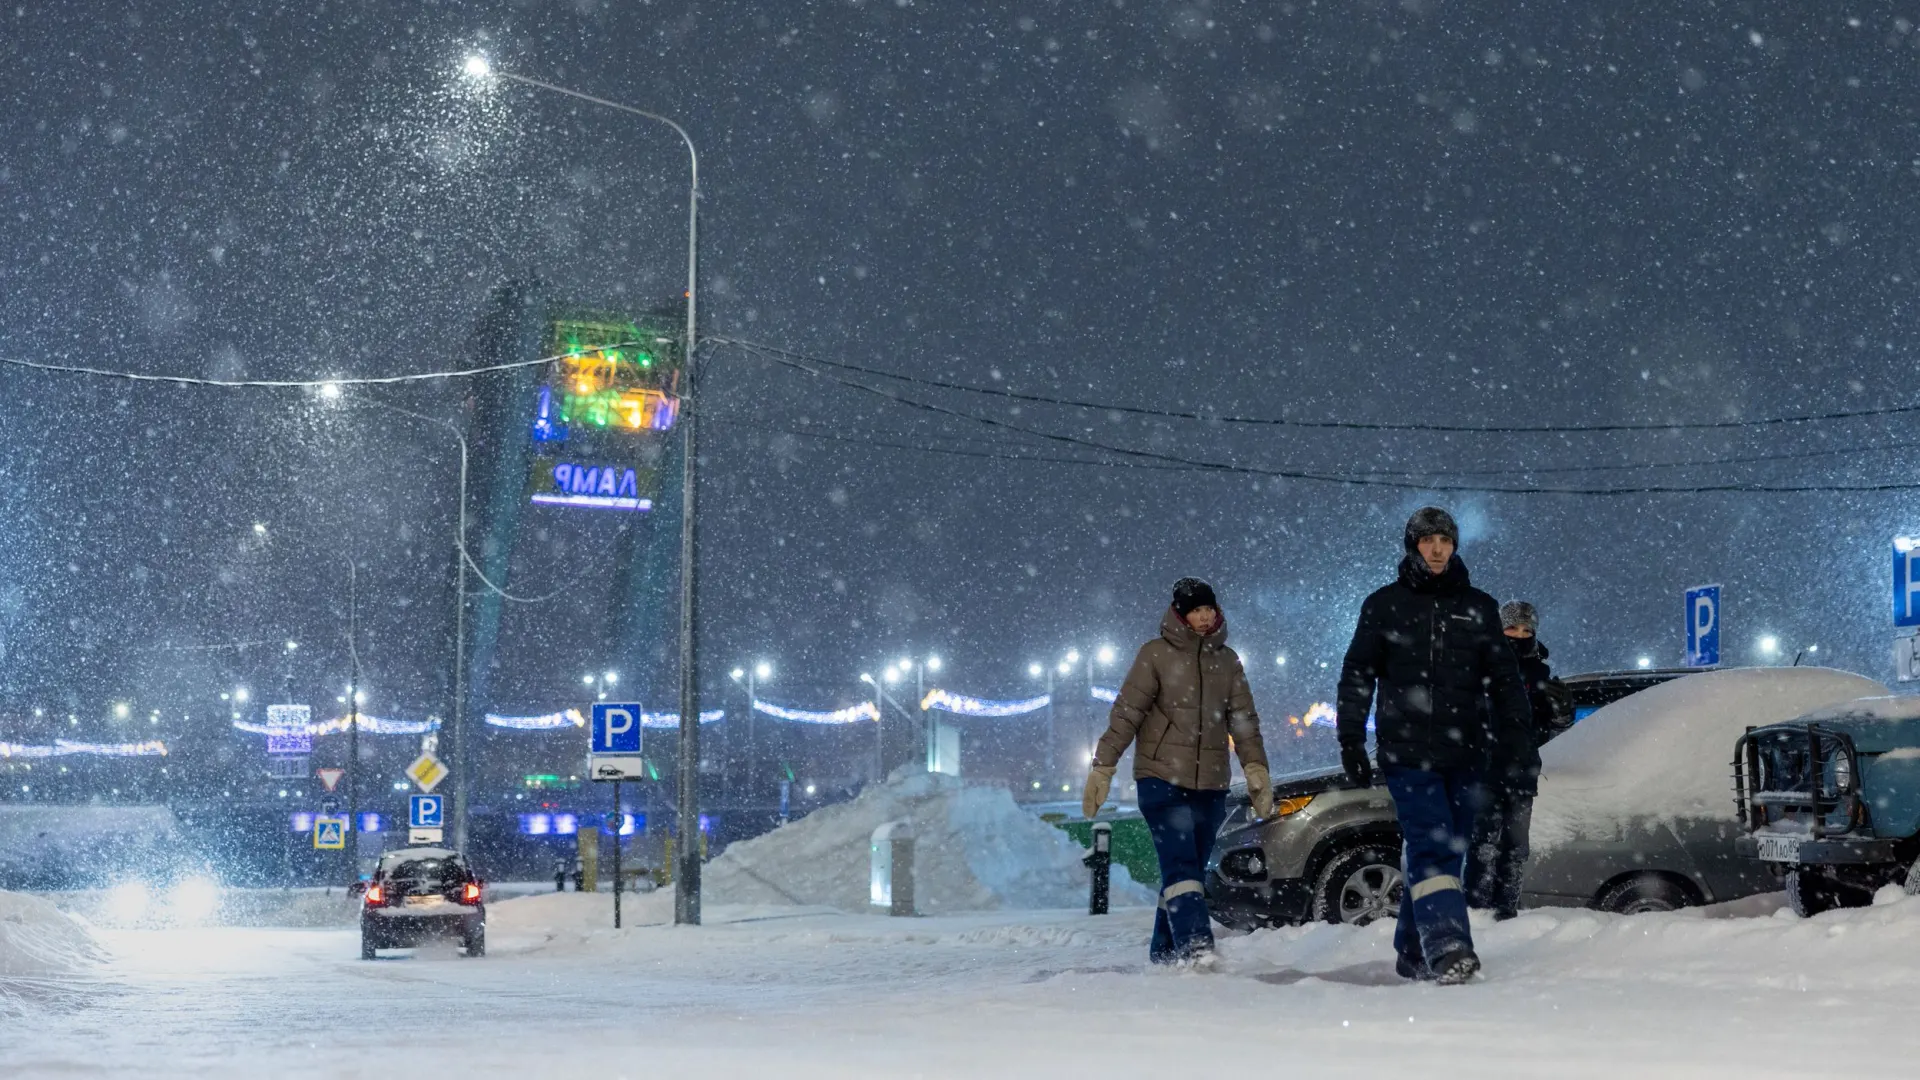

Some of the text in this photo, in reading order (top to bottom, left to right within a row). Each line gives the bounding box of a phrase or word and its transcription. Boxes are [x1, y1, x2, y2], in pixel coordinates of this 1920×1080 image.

[1695, 596, 1714, 658] P
[605, 708, 633, 748] P
[419, 798, 437, 825] P
